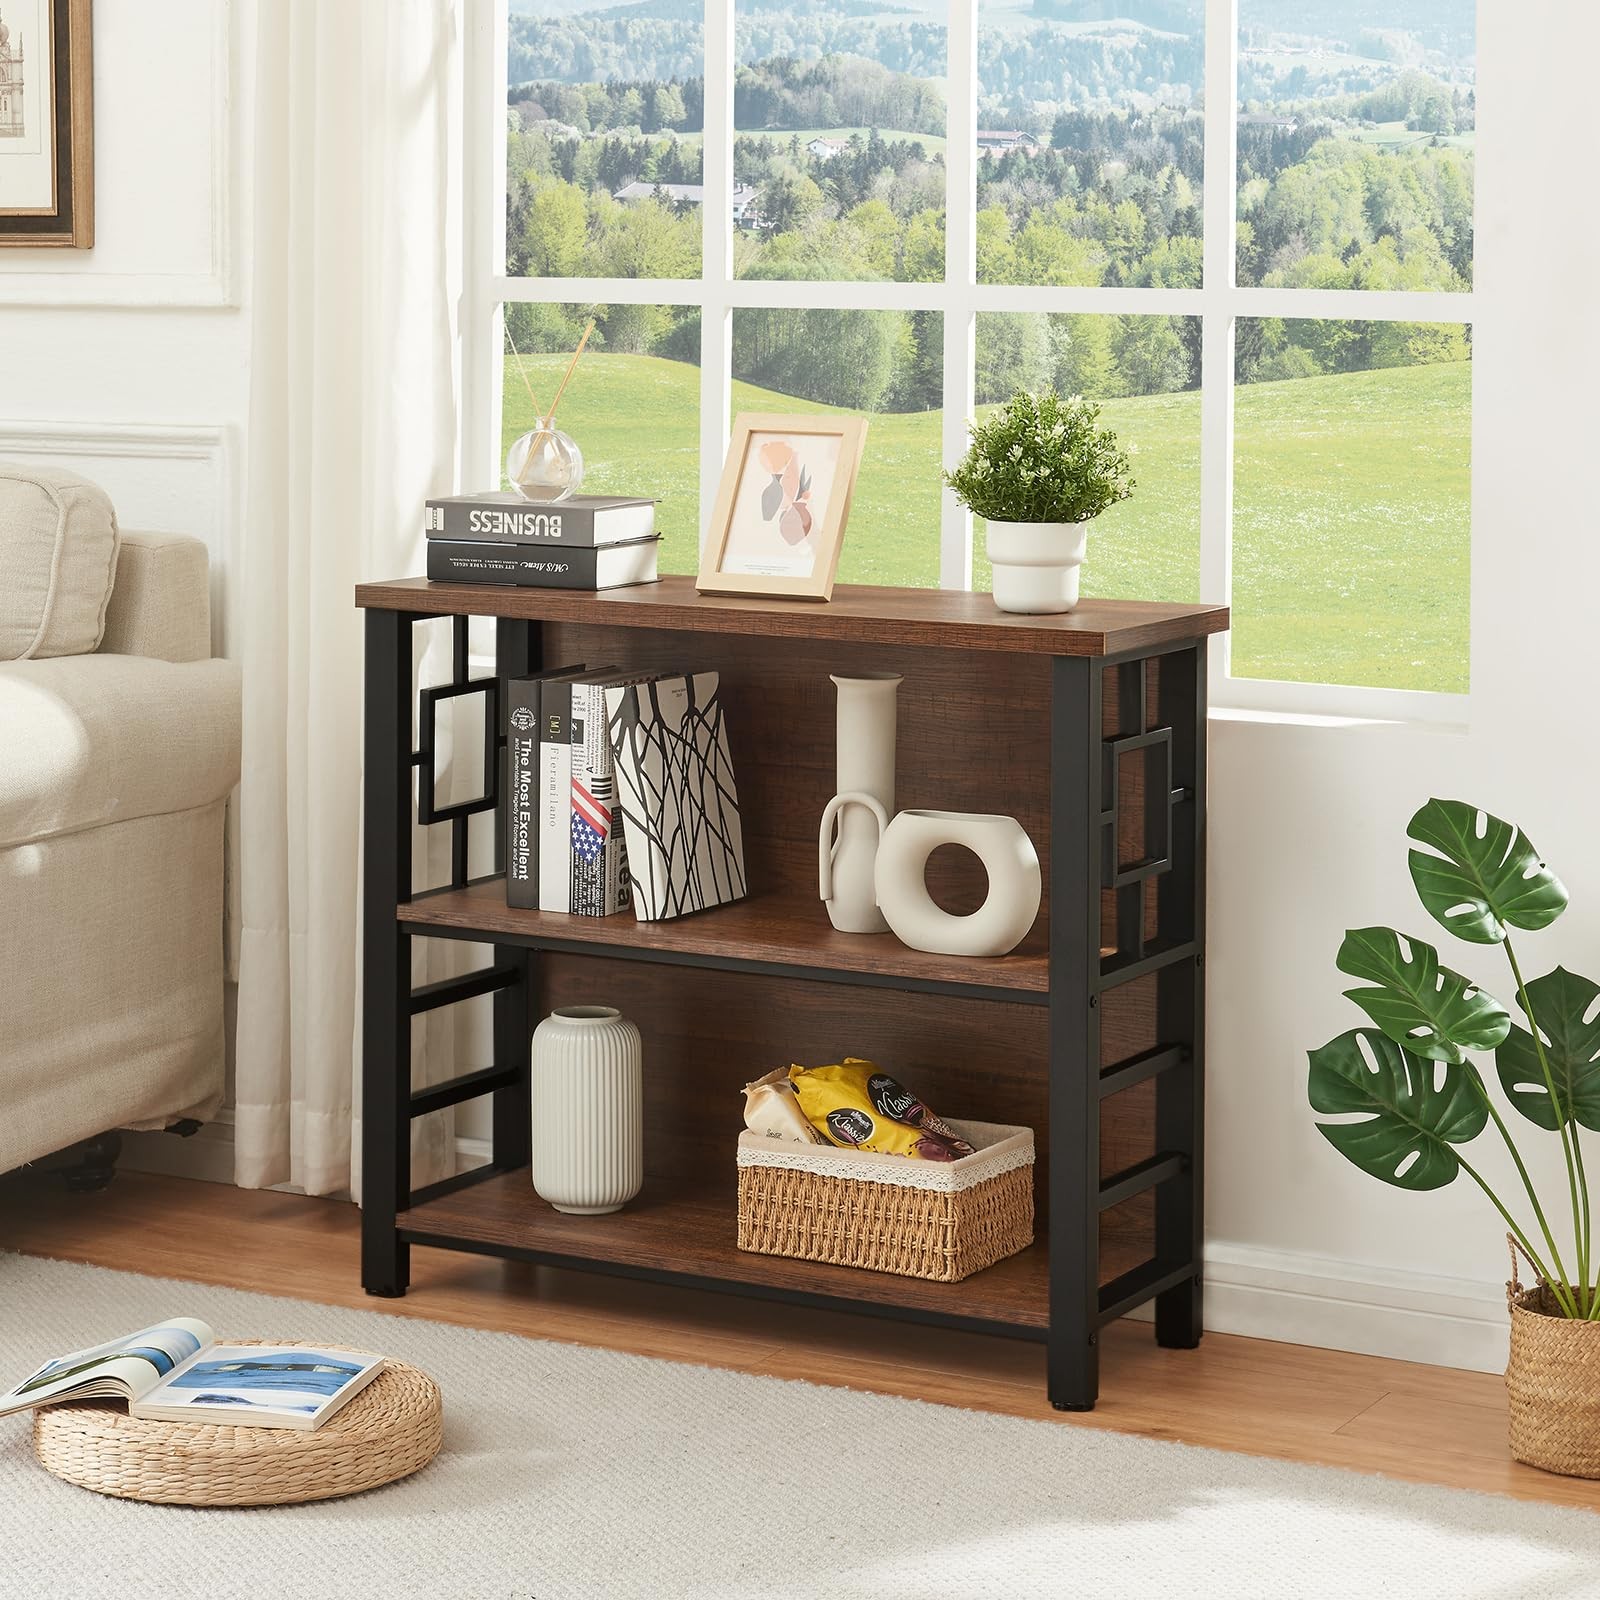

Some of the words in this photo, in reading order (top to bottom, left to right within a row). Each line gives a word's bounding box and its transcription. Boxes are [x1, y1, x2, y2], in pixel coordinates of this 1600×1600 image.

[469, 510, 562, 538] BUSINESS
[520, 738, 532, 767] The
[519, 770, 531, 808] Most
[549, 746, 559, 828] Fieramilano
[512, 789, 520, 816] Tragedy
[513, 816, 519, 824] of
[518, 811, 531, 881] Excellent
